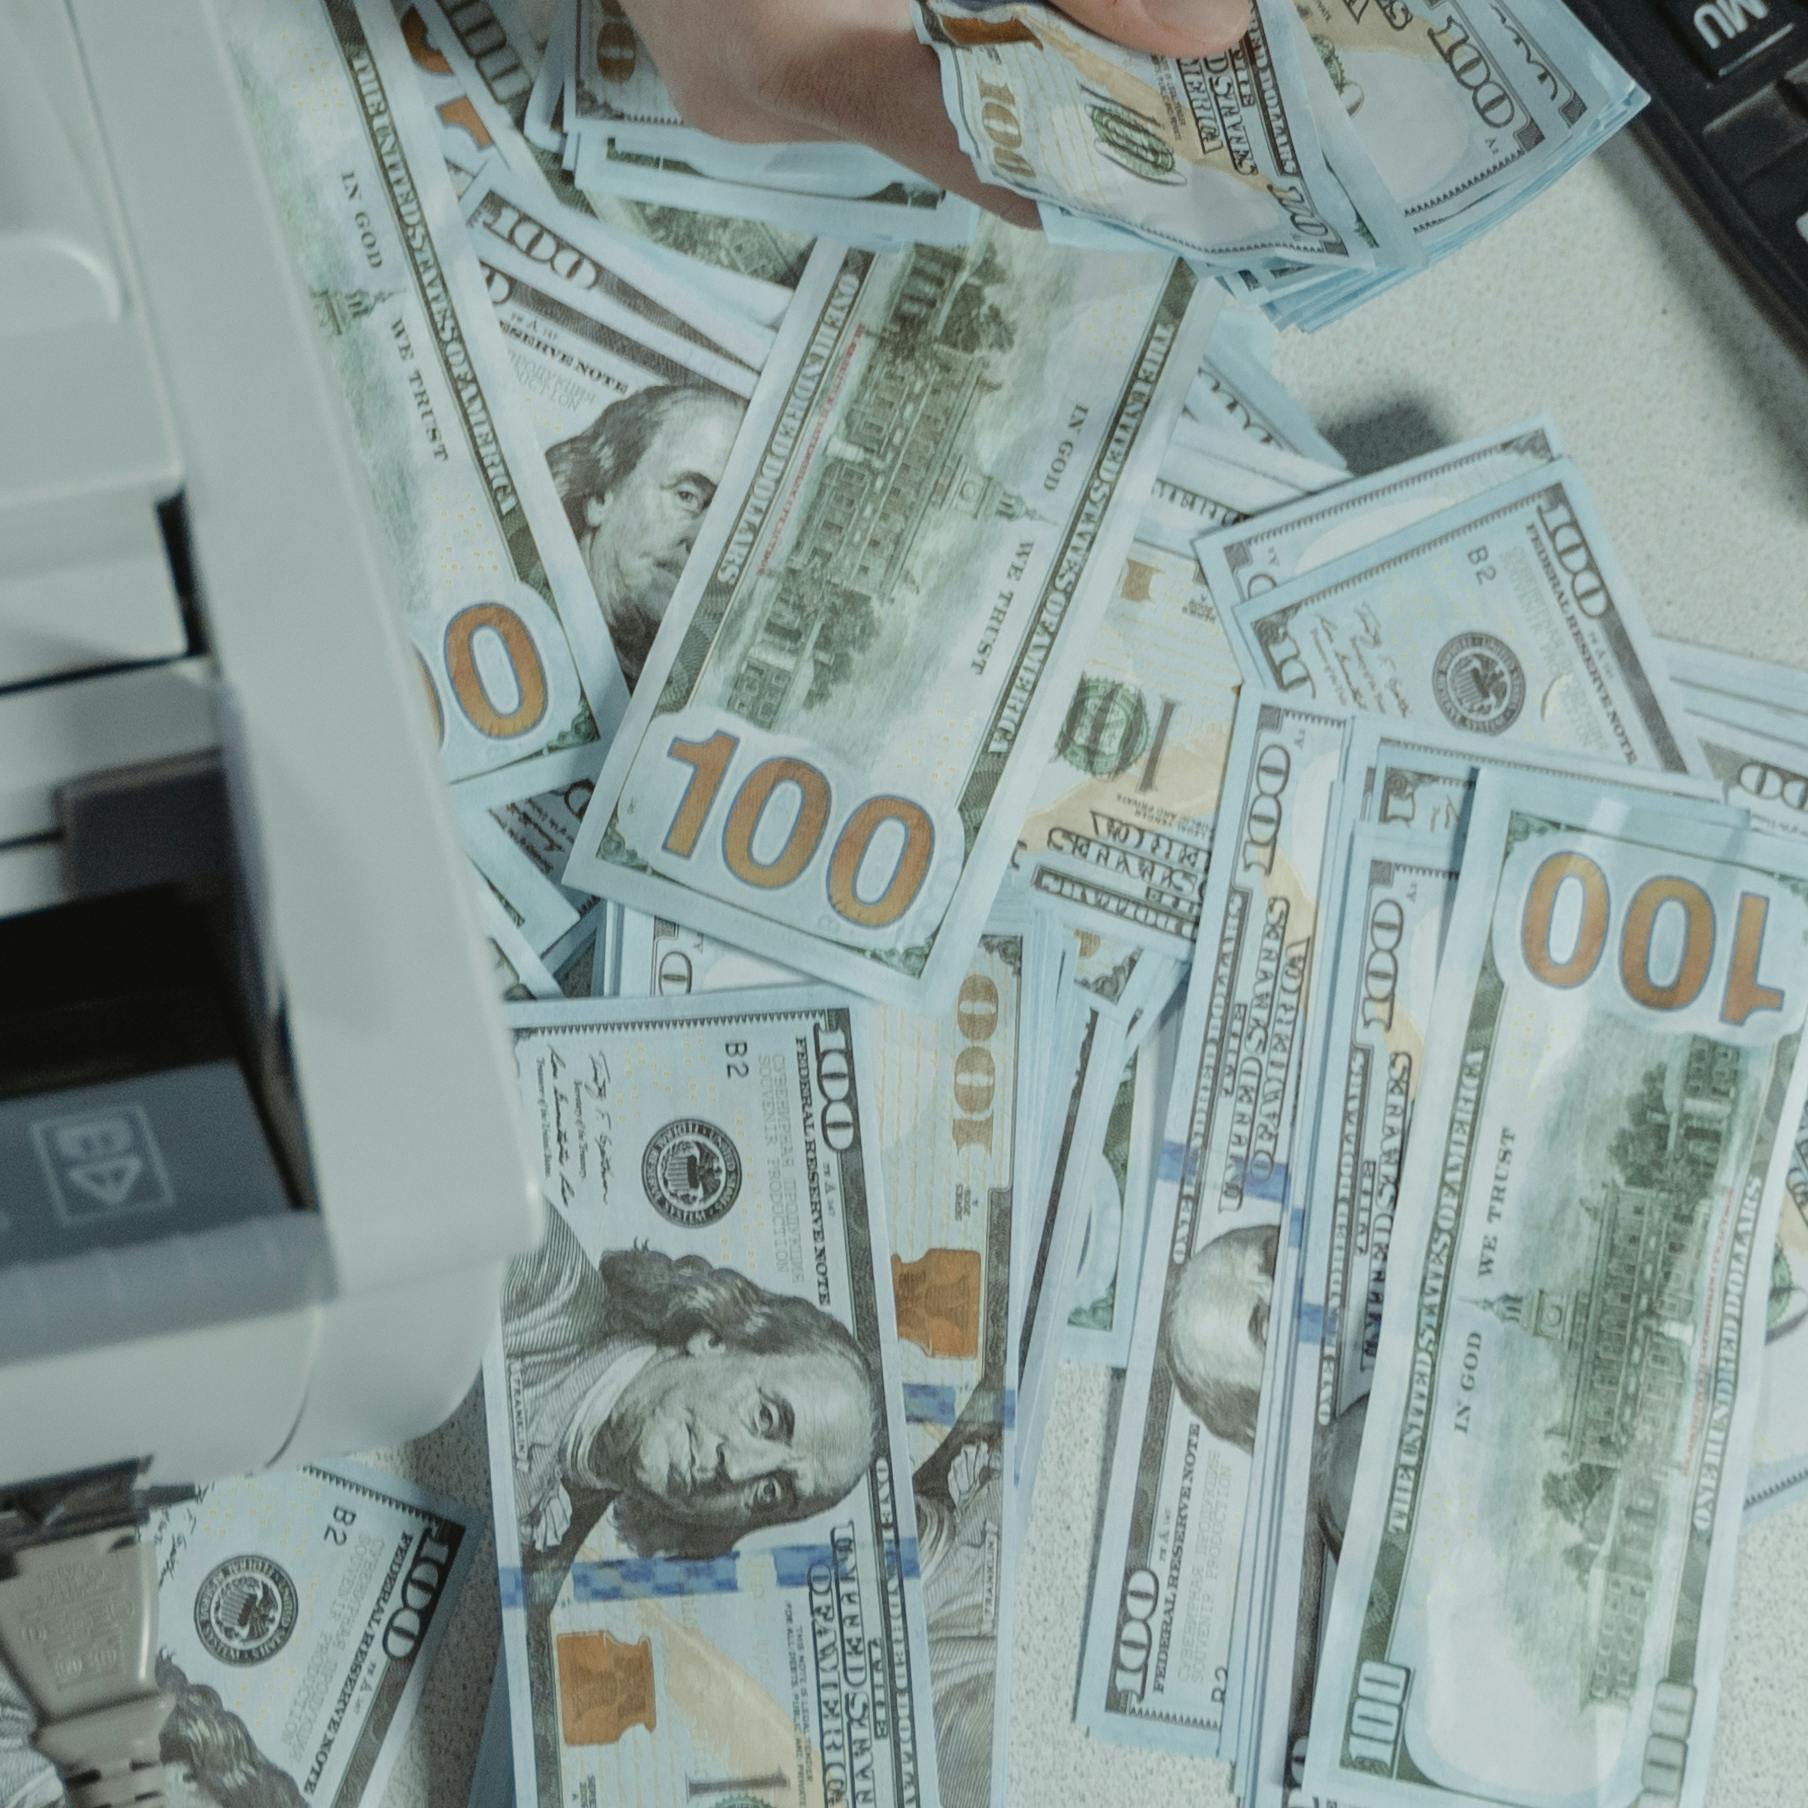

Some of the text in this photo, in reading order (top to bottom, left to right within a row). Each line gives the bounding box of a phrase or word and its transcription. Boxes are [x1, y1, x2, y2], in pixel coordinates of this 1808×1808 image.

[1206, 69, 1261, 179] STATES
[1423, 11, 1522, 133] 100
[338, 169, 452, 465] IN GOD WE TRUST
[479, 200, 605, 294] 100
[714, 269, 863, 588] ONE HUNDRED DOLLARS
[966, 402, 1090, 677] IN GOD WE TRUST
[1464, 544, 1499, 586] B2
[1532, 496, 1613, 620] 100
[1523, 520, 1640, 766] FEDERAL RESERVE NOTE
[662, 732, 936, 926] 100
[1239, 742, 1293, 876] 100
[1357, 898, 1407, 1033] 100
[1520, 850, 1785, 1026] 100
[724, 1040, 749, 1079] B2
[812, 1021, 854, 1152] 100
[952, 973, 998, 1155] 100
[1169, 894, 1247, 1265] ONE HUNDRED DOLLARS
[1217, 896, 1291, 1216] UNITED STATES
[757, 1053, 789, 1274] SOUVENIR PRODUCTION
[793, 1036, 830, 1307] FEDERAL RESERVE NOTE
[1314, 1049, 1368, 1426] ONE HUNDRED DOLLARS
[1384, 1044, 1486, 1535] THE UNITED STATES OF AMERICA
[1452, 1123, 1516, 1433] IN GOD WE TRUST
[1692, 1172, 1764, 1531] ONE HUNDRED DOLLARS
[322, 1504, 357, 1547] B2
[375, 1525, 454, 1665] 100
[1152, 1421, 1201, 1694] FEDERAL RESERVE NOTE
[1203, 1463, 1232, 1581] PRODUCTION
[300, 1531, 415, 1797] FEDERAL RESERVE NOTE
[866, 1637, 888, 1741] THE
[874, 1456, 920, 1807] ONE HUNDRED DOLLA
[1111, 1566, 1163, 1696] 100
[1345, 1659, 1410, 1768] 100
